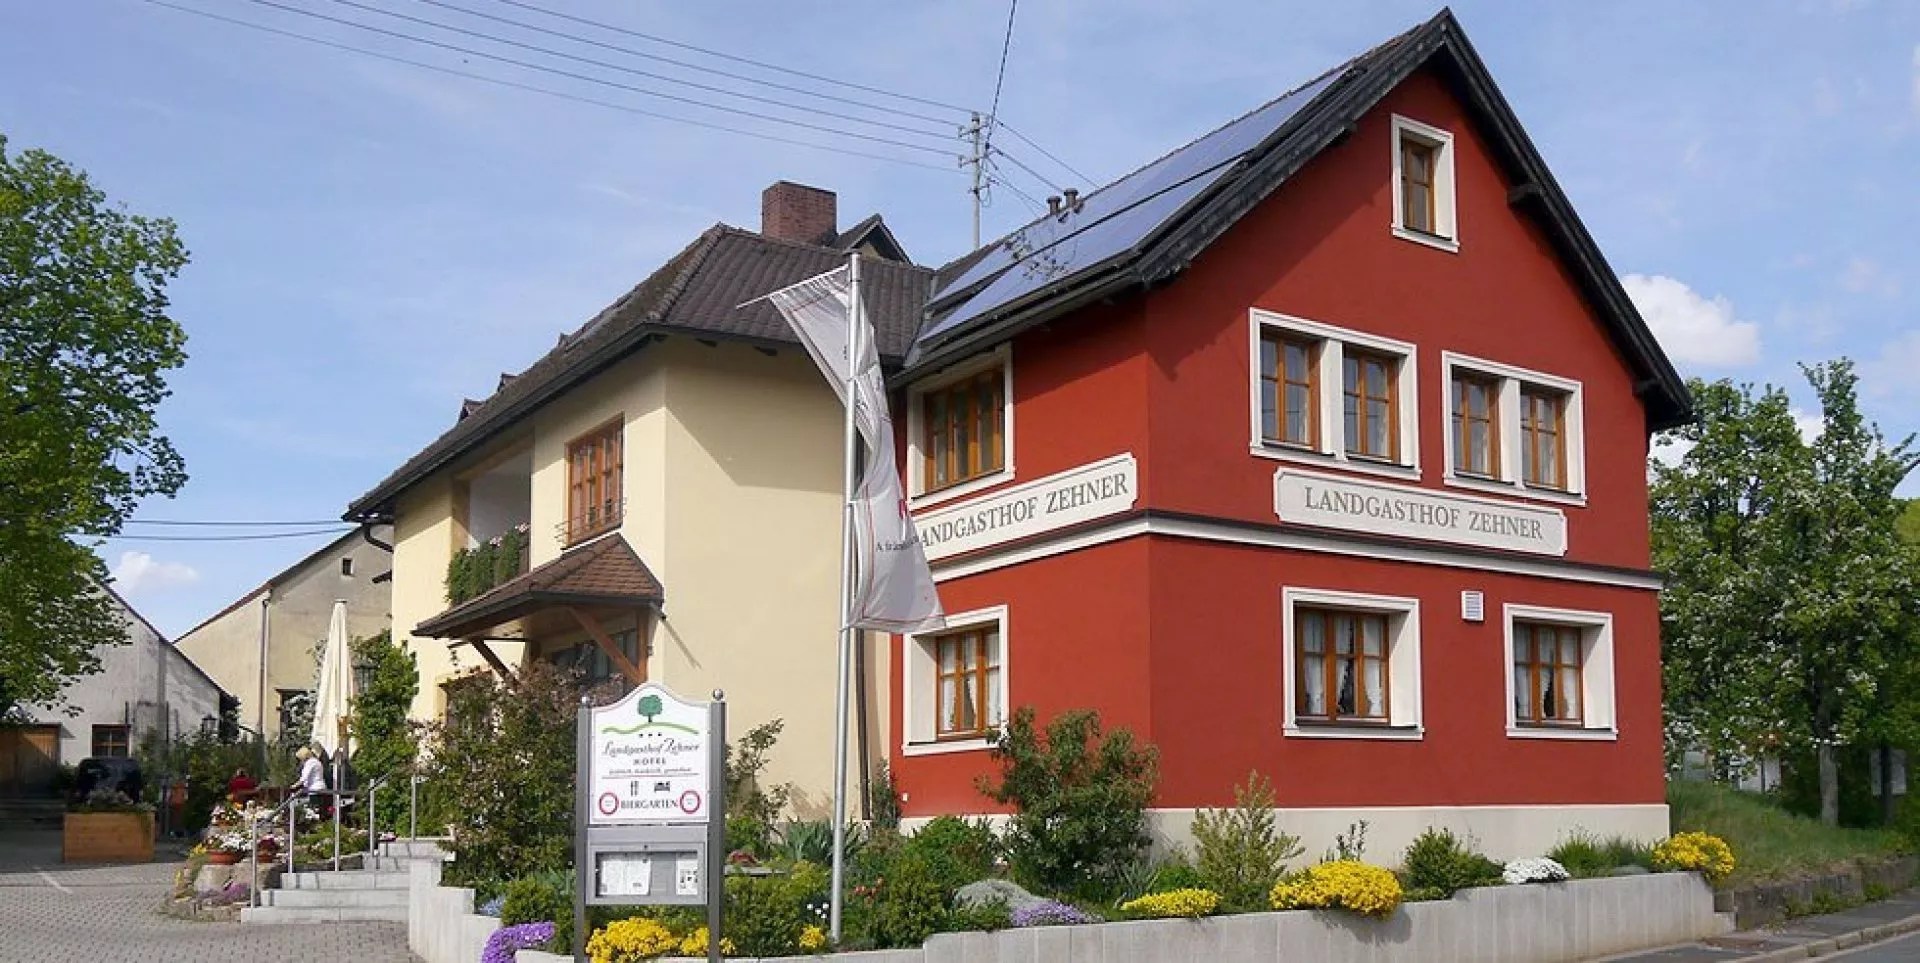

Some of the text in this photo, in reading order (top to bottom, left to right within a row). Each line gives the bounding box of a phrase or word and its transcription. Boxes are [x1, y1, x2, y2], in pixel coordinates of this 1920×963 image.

[921, 473, 1129, 547] ANDGASTHOF ZEHNER
[1304, 486, 1543, 540] LANDGASTHOF ZEHNER
[633, 757, 666, 765] HOTEL
[621, 799, 678, 809] BIERGARTEN
